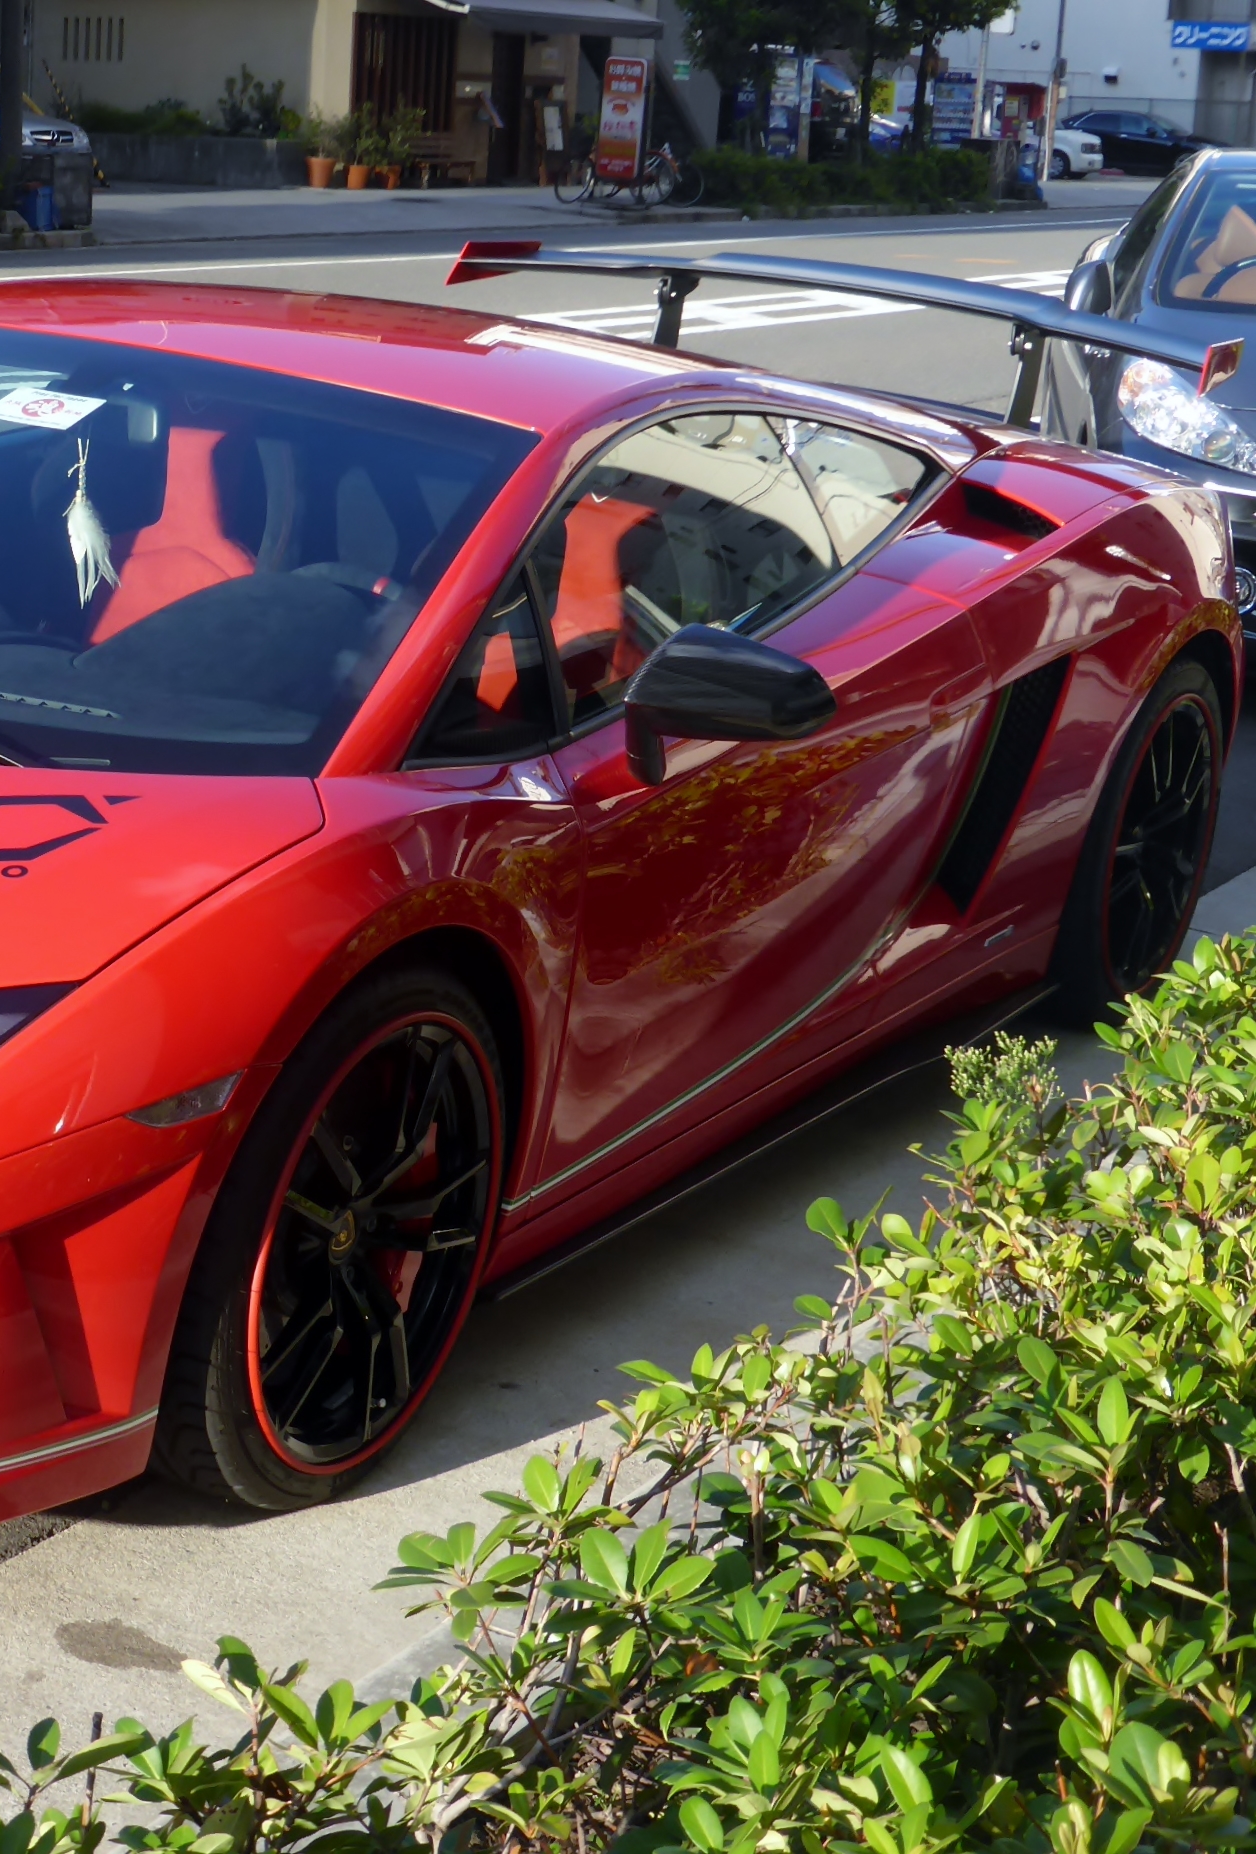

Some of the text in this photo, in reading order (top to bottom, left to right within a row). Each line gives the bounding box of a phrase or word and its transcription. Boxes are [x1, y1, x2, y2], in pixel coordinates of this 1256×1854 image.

[1173, 24, 1248, 46] クリーニング
[737, 92, 756, 103] BOS
